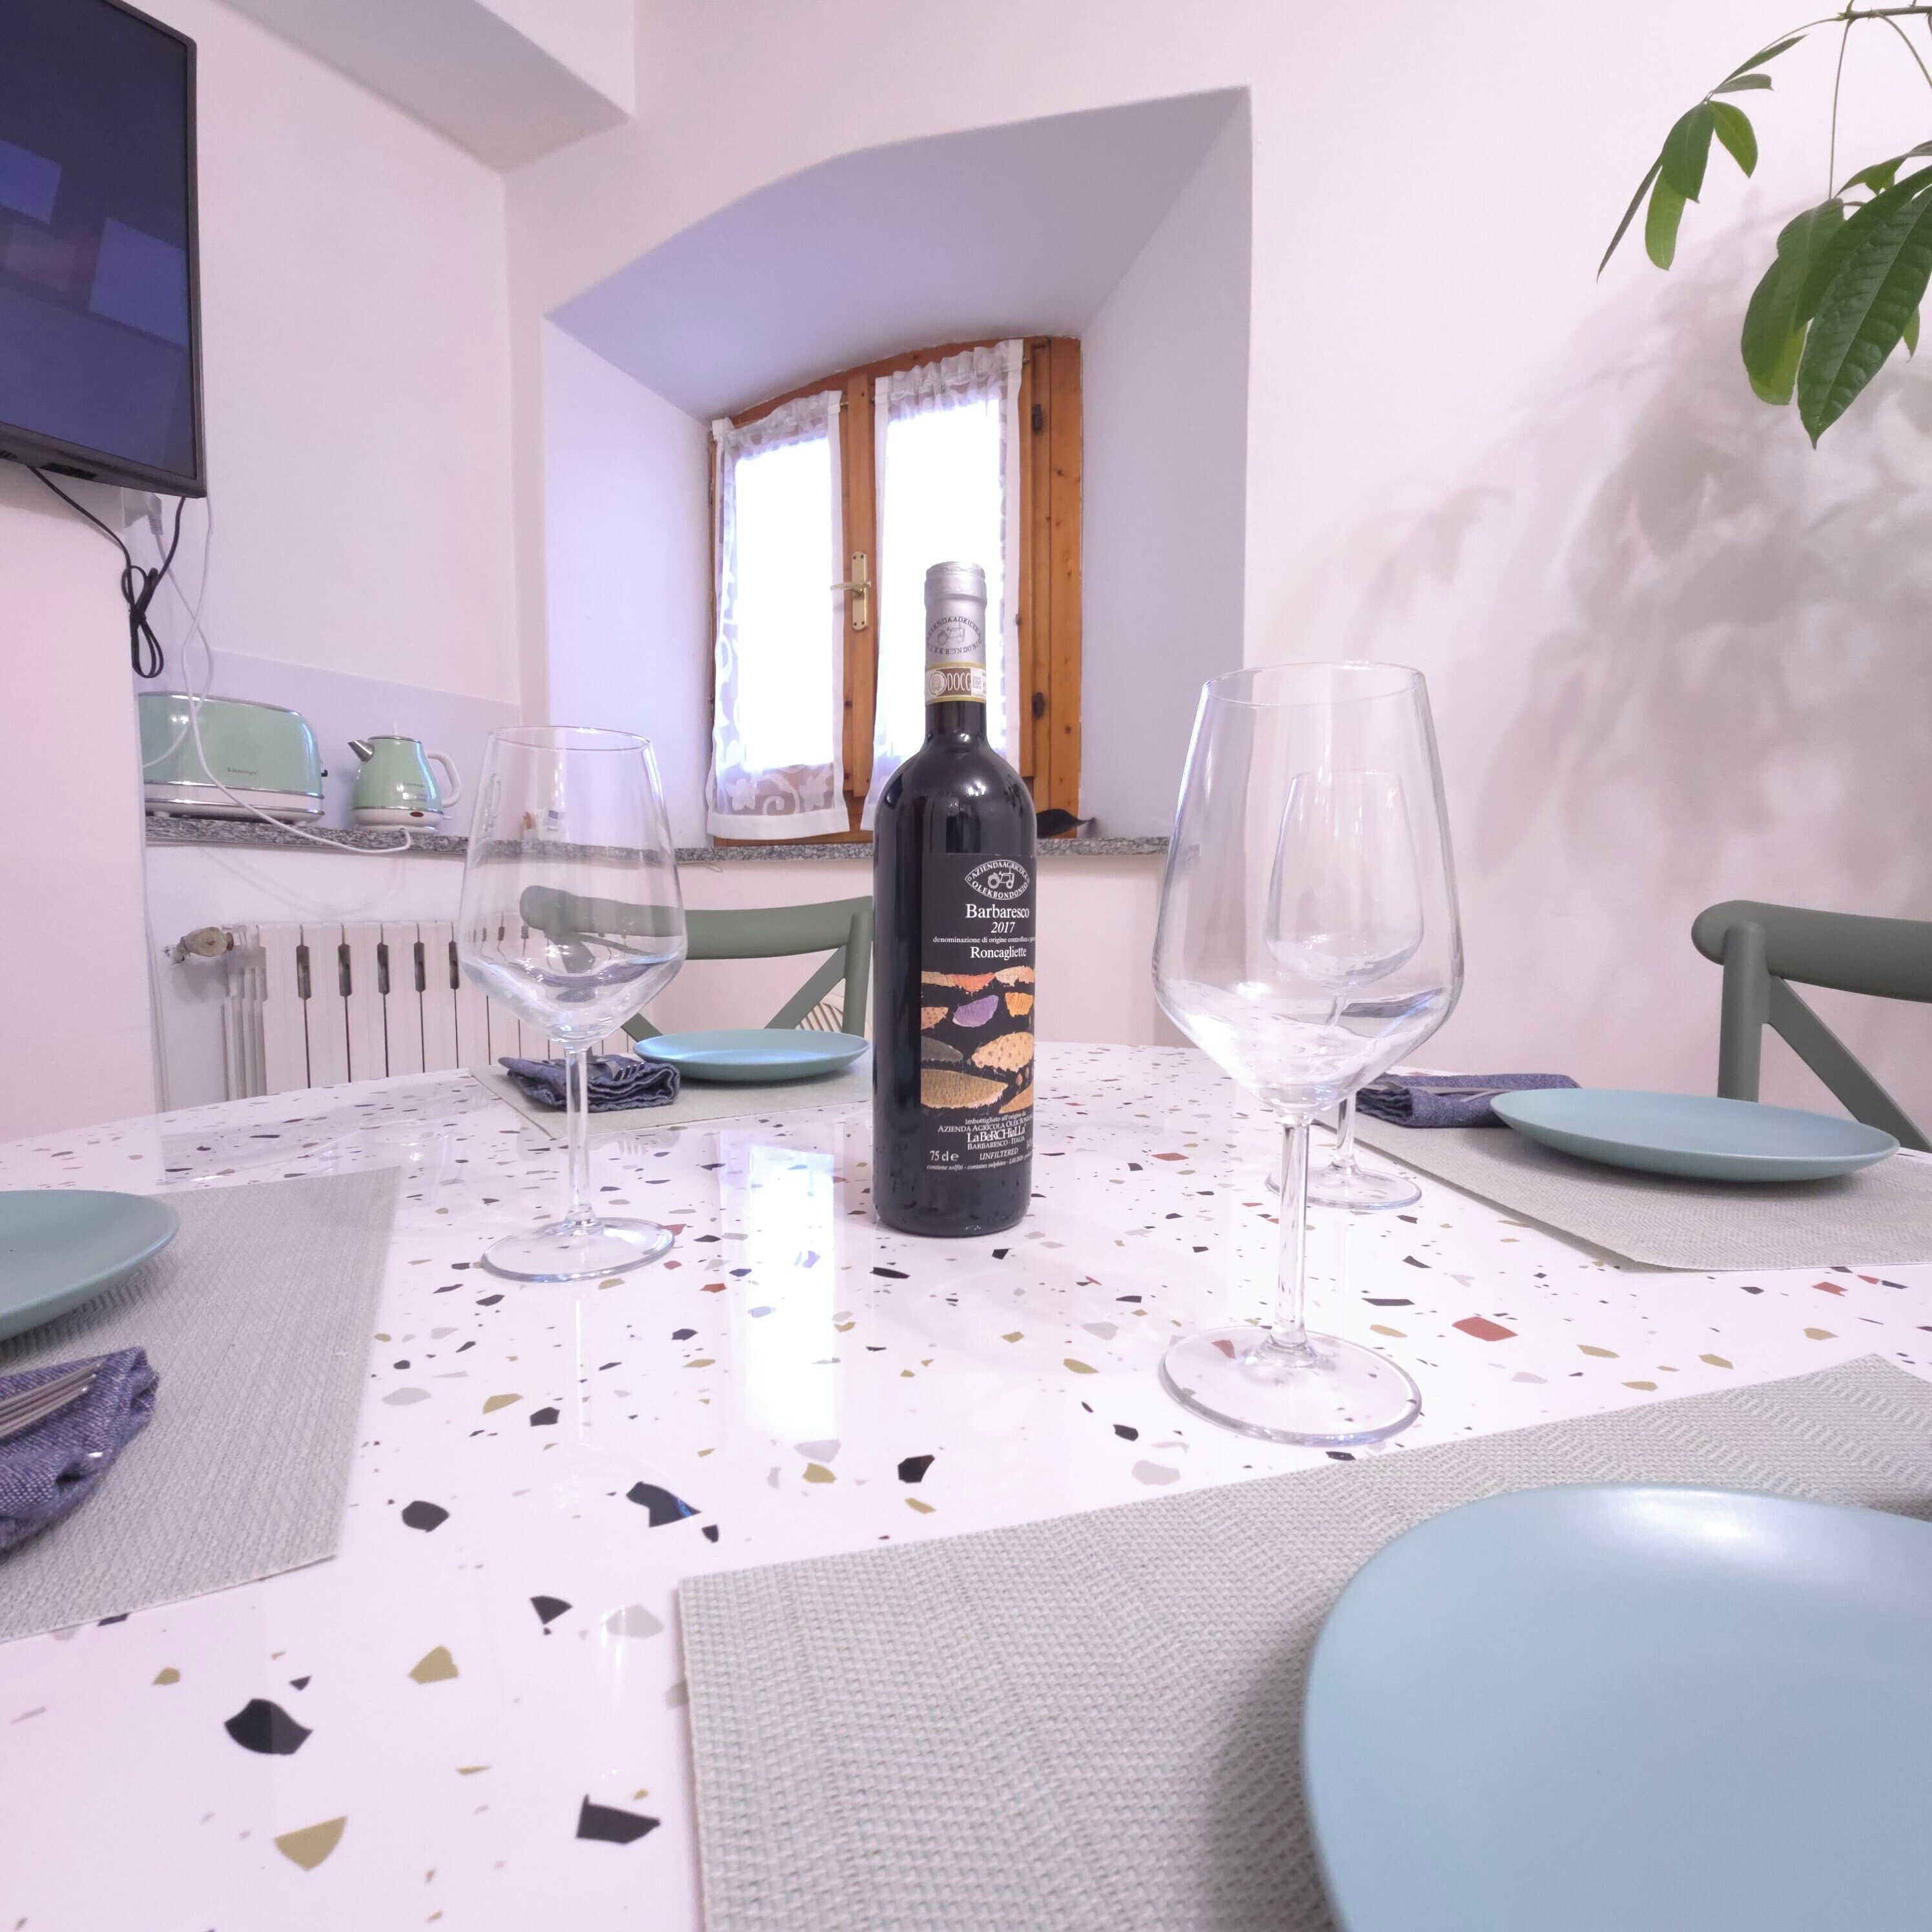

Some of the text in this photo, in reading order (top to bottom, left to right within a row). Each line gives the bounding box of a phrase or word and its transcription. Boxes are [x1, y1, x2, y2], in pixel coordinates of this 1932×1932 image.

[947, 672, 971, 691] DOCG
[965, 904, 1029, 918] Barbaresco
[991, 921, 1016, 933] 2017
[971, 946, 1027, 961] Roncagliette
[965, 1116, 1001, 1125] imbottigliato
[972, 1122, 1005, 1132] AGRICOLA
[967, 1140, 1008, 1150] BARBARESCO
[1011, 1135, 1025, 1145] ITALIA
[930, 1151, 940, 1161] 75
[941, 1151, 949, 1161] cl
[979, 1147, 1019, 1160] UNFILTERED
